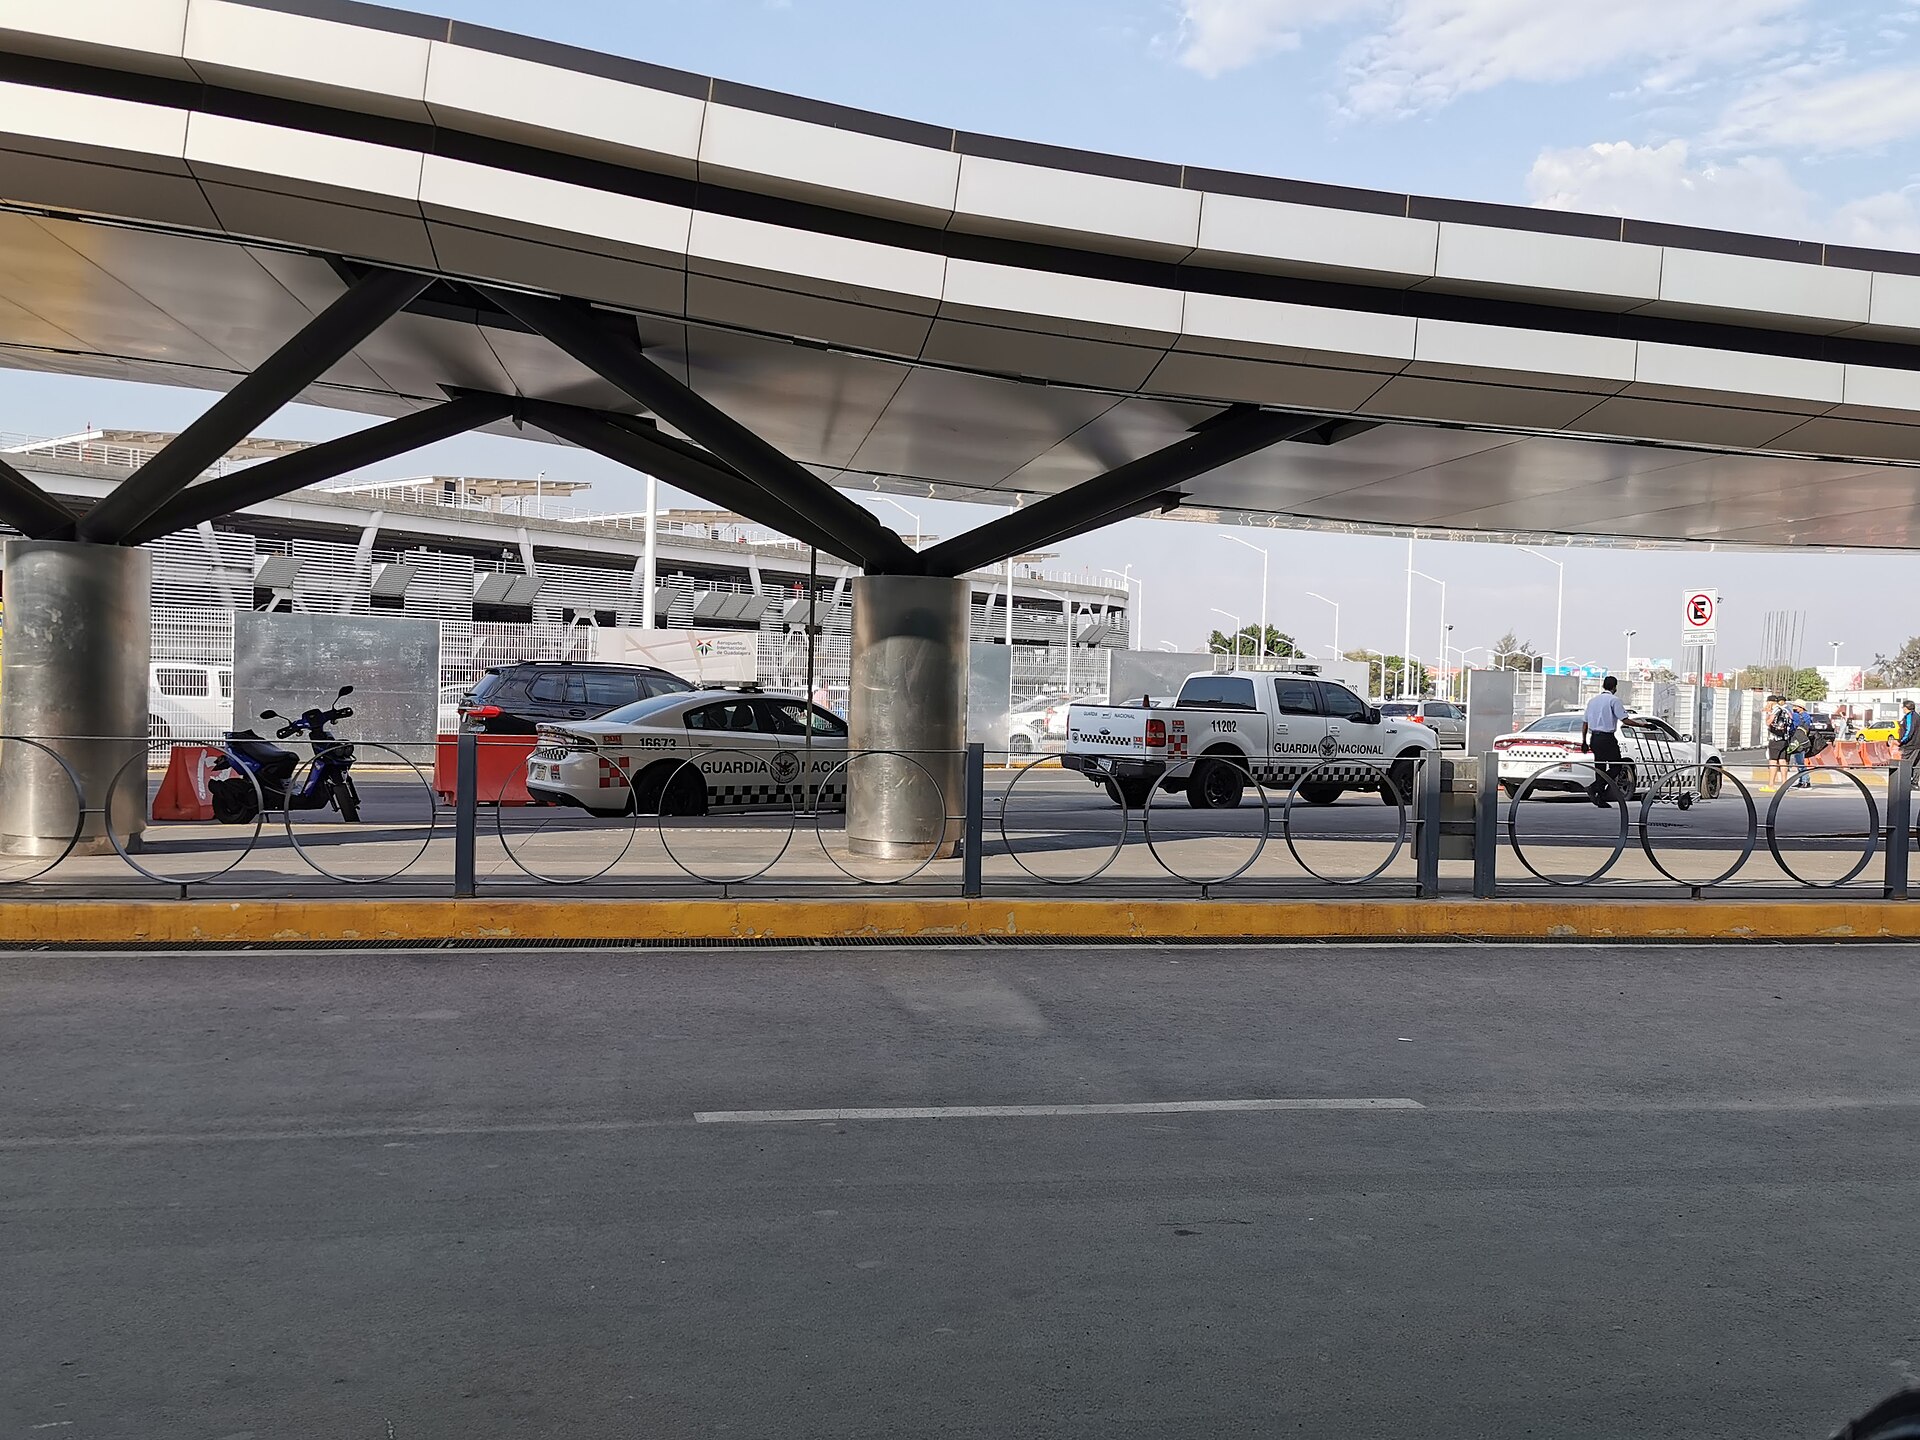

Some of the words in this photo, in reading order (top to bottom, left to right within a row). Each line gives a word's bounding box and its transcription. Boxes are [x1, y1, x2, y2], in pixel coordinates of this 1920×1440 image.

[1211, 720, 1237, 733] 11202
[639, 737, 677, 751] 16673
[1273, 742, 1318, 755] GUARDIA
[1337, 743, 1384, 755] NACIONAL
[700, 761, 768, 774] GUARDIA
[801, 760, 848, 773] ACIO
